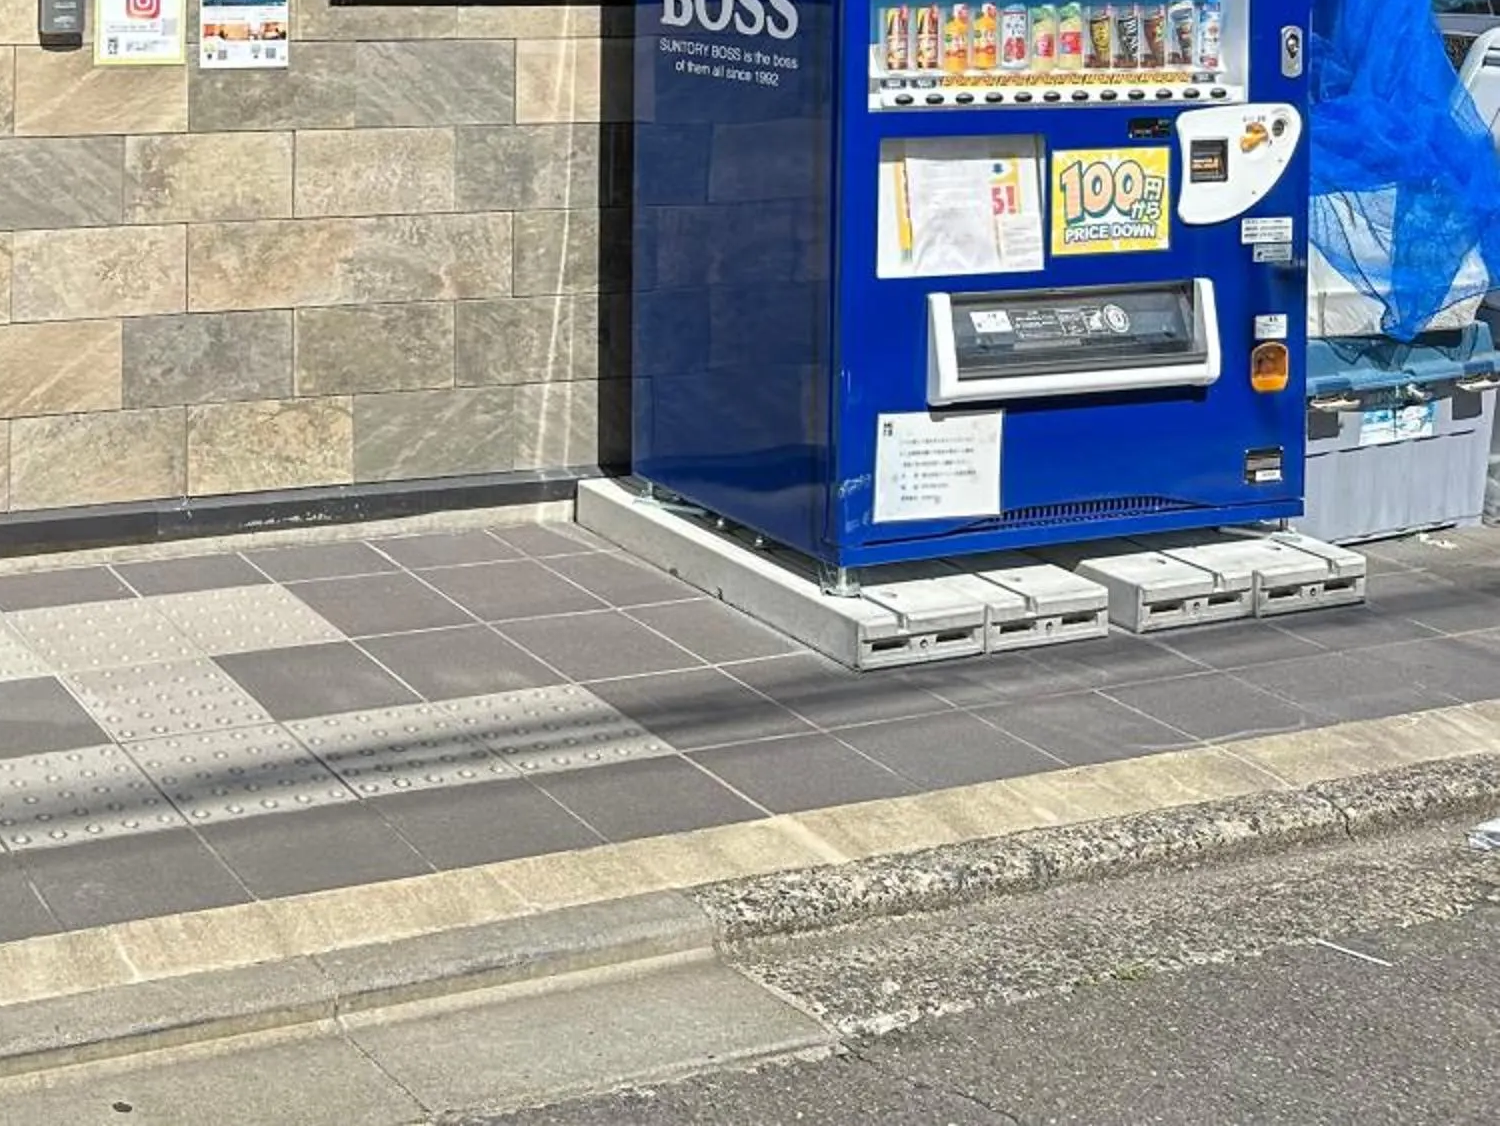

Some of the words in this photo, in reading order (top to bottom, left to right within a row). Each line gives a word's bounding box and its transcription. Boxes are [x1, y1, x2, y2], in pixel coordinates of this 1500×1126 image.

[659, 37, 709, 57] SUNTORY
[711, 45, 741, 62] BOSS
[744, 50, 753, 63] is
[754, 51, 771, 66] the
[773, 54, 798, 70] boss
[675, 60, 686, 72] of
[687, 61, 711, 75] them
[712, 65, 725, 78] all
[726, 67, 752, 82] since
[1064, 223, 1109, 244] PRICE
[1112, 221, 1156, 239] DOWN
